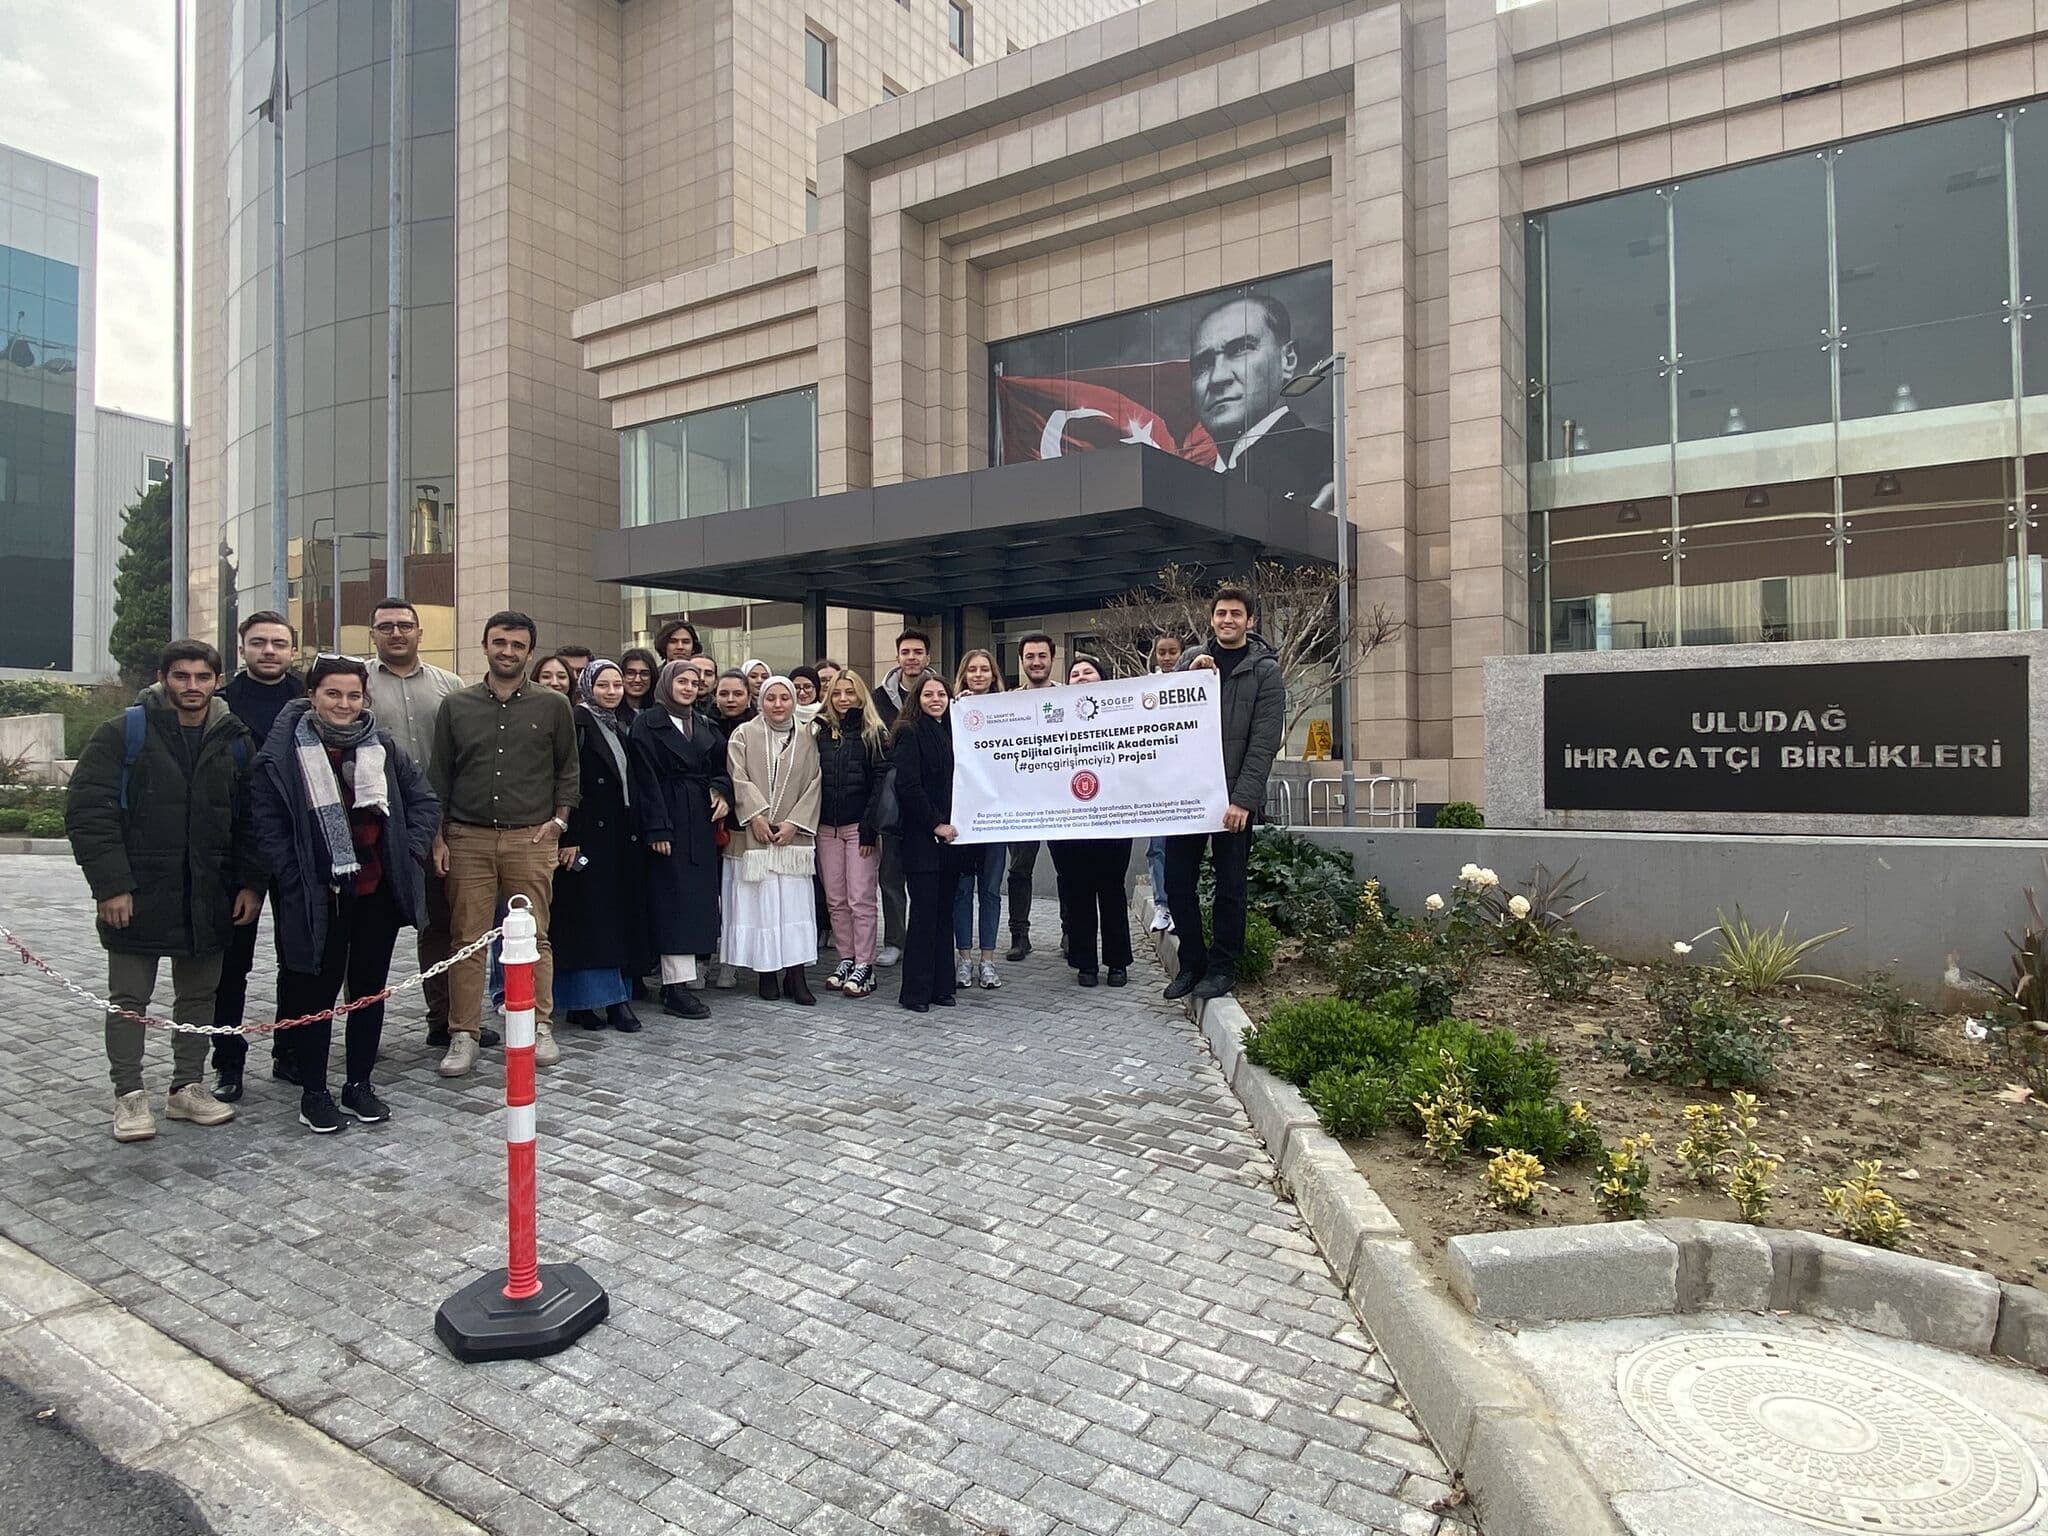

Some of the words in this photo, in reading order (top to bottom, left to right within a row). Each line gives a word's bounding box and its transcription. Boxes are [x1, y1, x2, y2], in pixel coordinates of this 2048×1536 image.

[1100, 696, 1134, 707] SOGEP
[1159, 687, 1207, 705] BEBKA
[1691, 703, 1849, 734] ULUDAĞ
[974, 739, 1014, 750] SOSYAL
[1015, 731, 1069, 748] GELİŞMEYİ
[1070, 726, 1136, 742] DESTEKLEME
[1136, 720, 1199, 735] PROGRAMI
[993, 751, 1019, 764] Genç
[1021, 745, 1053, 760] Dijital
[1053, 741, 1115, 756] Girişimcilik
[1116, 734, 1179, 750] Akademisi
[1014, 752, 1116, 774] (#gençgirişimciyiz)
[1118, 749, 1157, 764] Projesi
[1563, 743, 1760, 775] İHRACATÇI
[1780, 738, 2002, 770] BİRLİKLERİ
